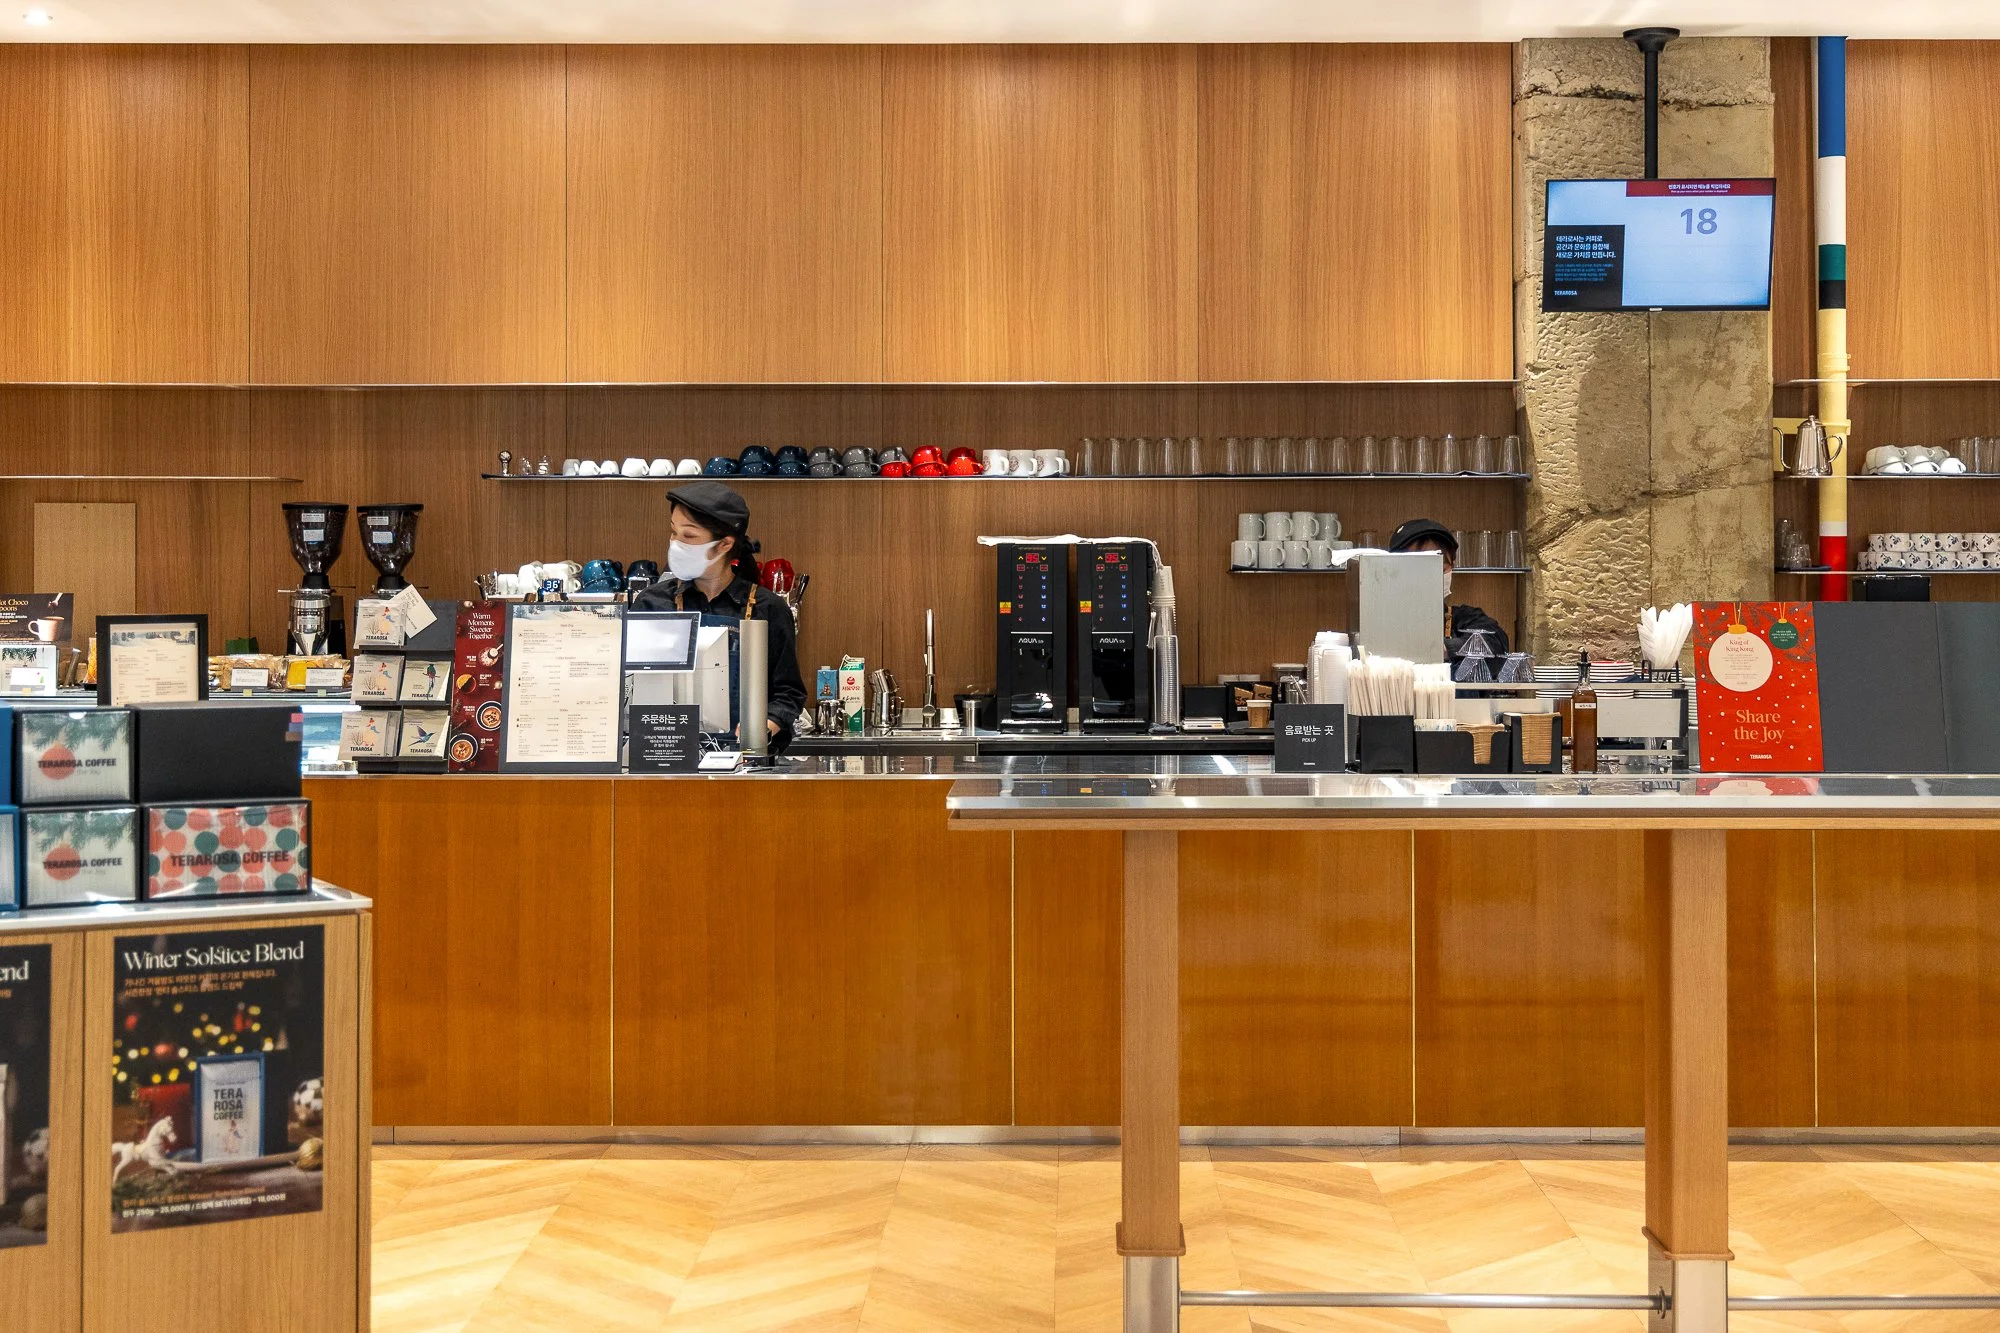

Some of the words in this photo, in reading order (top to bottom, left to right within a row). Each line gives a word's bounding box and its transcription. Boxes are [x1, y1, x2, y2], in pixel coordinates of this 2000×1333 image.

[1681, 208, 1717, 234] 18
[641, 714, 676, 724] 주문하는
[679, 714, 688, 724] 곳
[1736, 709, 1781, 723] Share
[1284, 725, 1321, 736] 음료받는
[1324, 725, 1334, 736] 곳
[1734, 726, 1759, 740] the
[1761, 726, 1784, 744] Joy
[38, 759, 82, 768] TERAROSA
[85, 758, 116, 767] COFFEE
[43, 860, 88, 869] TERAROSA
[90, 858, 122, 867] COFFEE
[170, 852, 239, 867] TERAROSA
[242, 850, 289, 864] COFFEE
[124, 952, 182, 970] Winter
[186, 946, 251, 967] Solstice
[255, 940, 304, 962] Blend
[214, 1088, 243, 1099] TERA
[214, 1100, 243, 1111] ROSA
[214, 1112, 243, 1120] COFFEE
